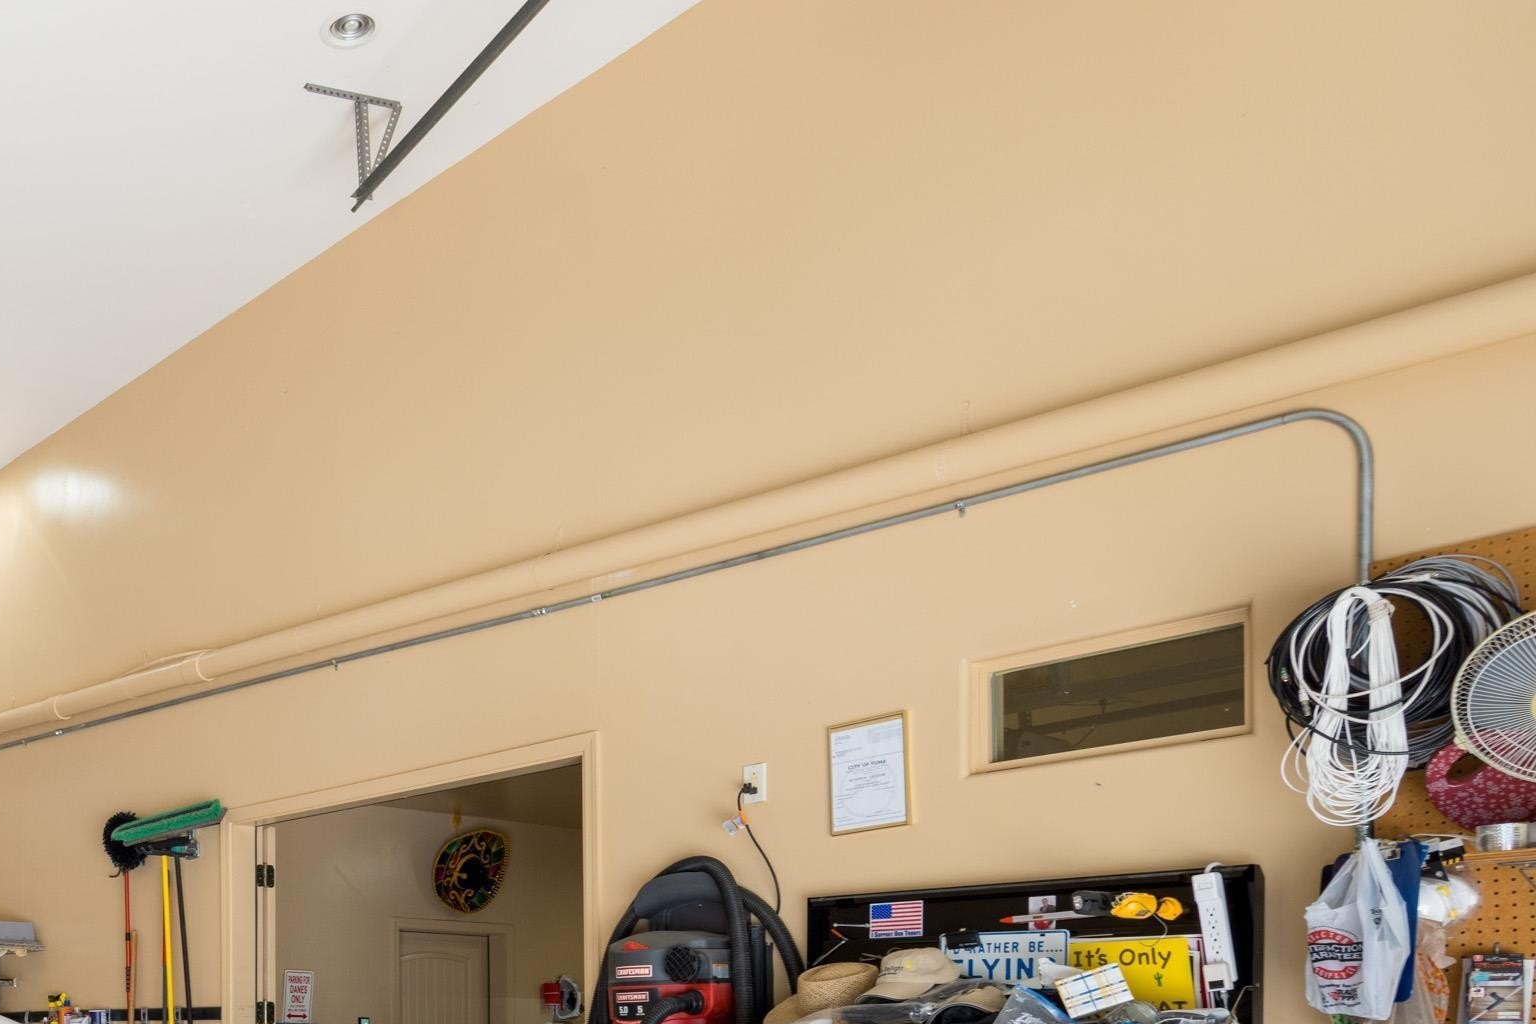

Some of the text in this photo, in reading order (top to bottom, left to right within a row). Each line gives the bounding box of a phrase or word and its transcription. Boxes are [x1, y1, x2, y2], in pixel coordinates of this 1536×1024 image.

[1073, 946, 1172, 969] It's Only
[290, 994, 306, 1003] ONLY
